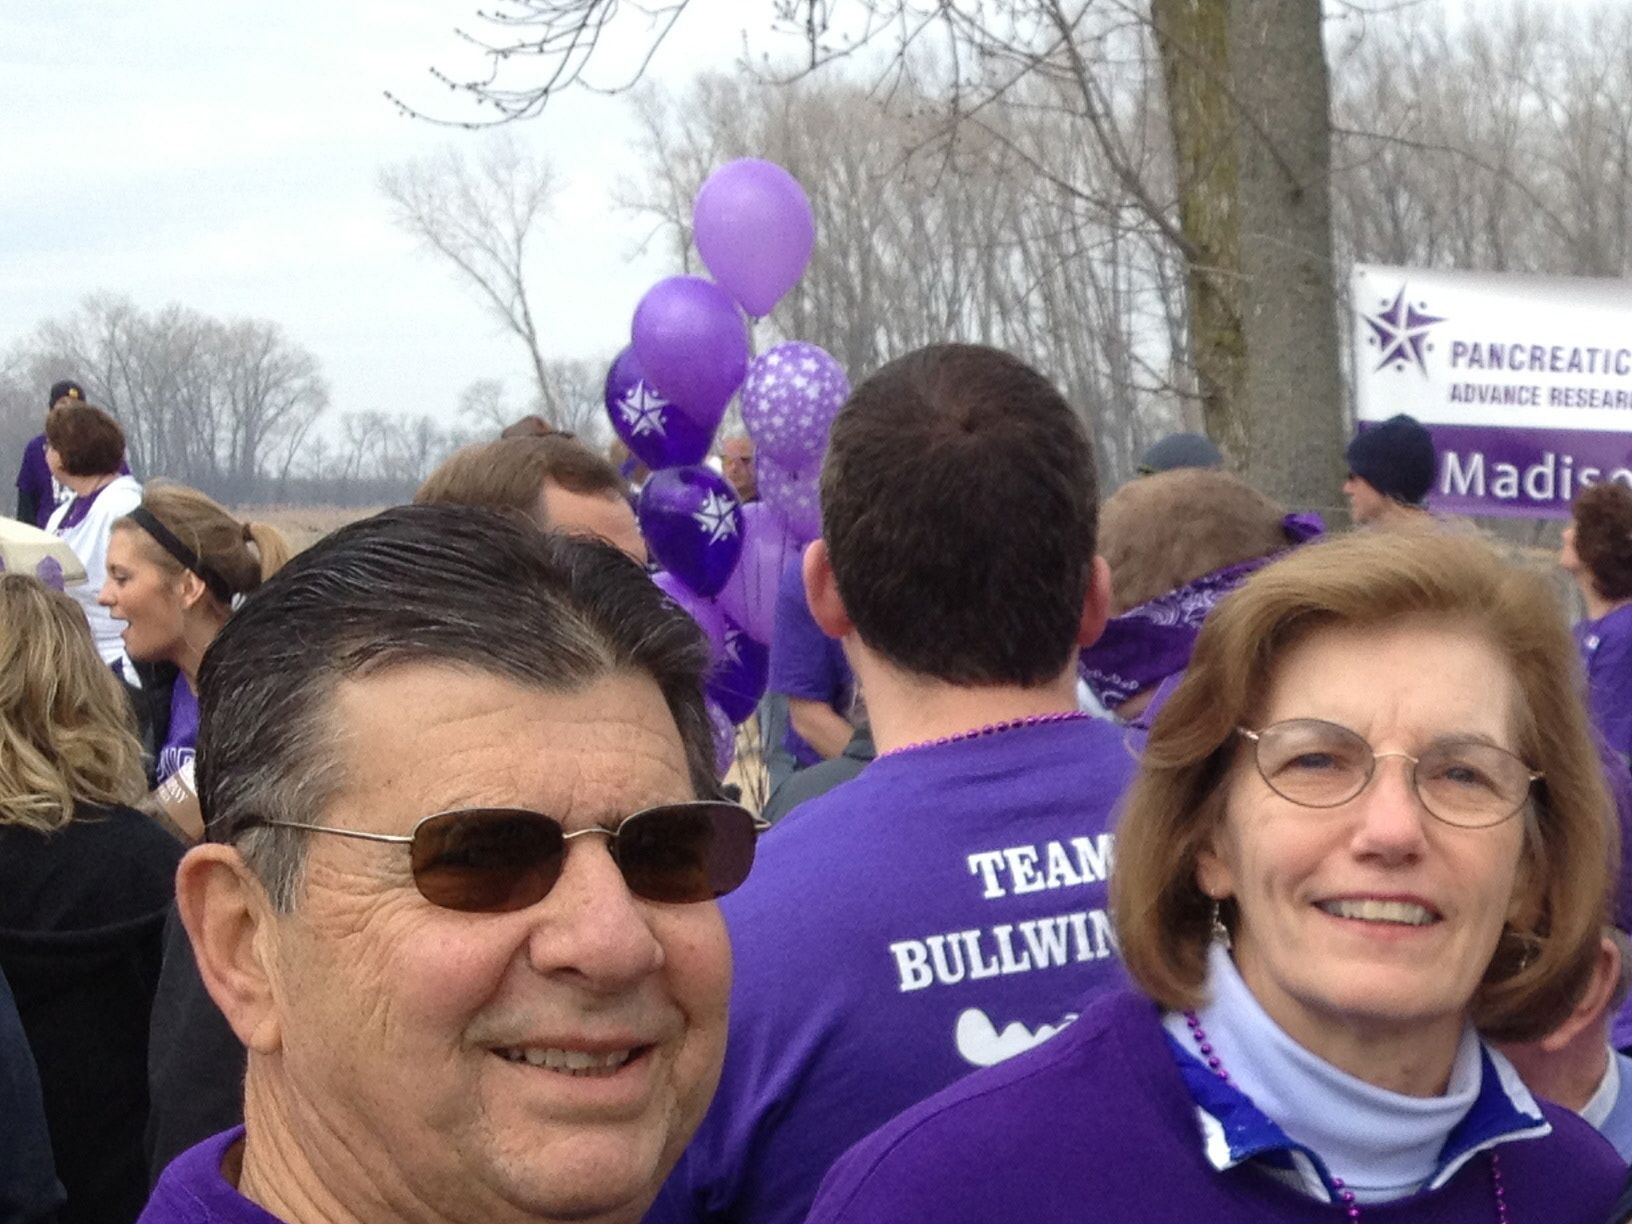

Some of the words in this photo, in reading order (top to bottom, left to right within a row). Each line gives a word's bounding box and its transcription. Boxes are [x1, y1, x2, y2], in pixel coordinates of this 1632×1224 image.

[1450, 341, 1632, 377] PANCREATIC
[1450, 384, 1542, 408] ADVANCE
[967, 833, 1114, 899] TEAM
[889, 909, 1119, 992] BULLWIN
